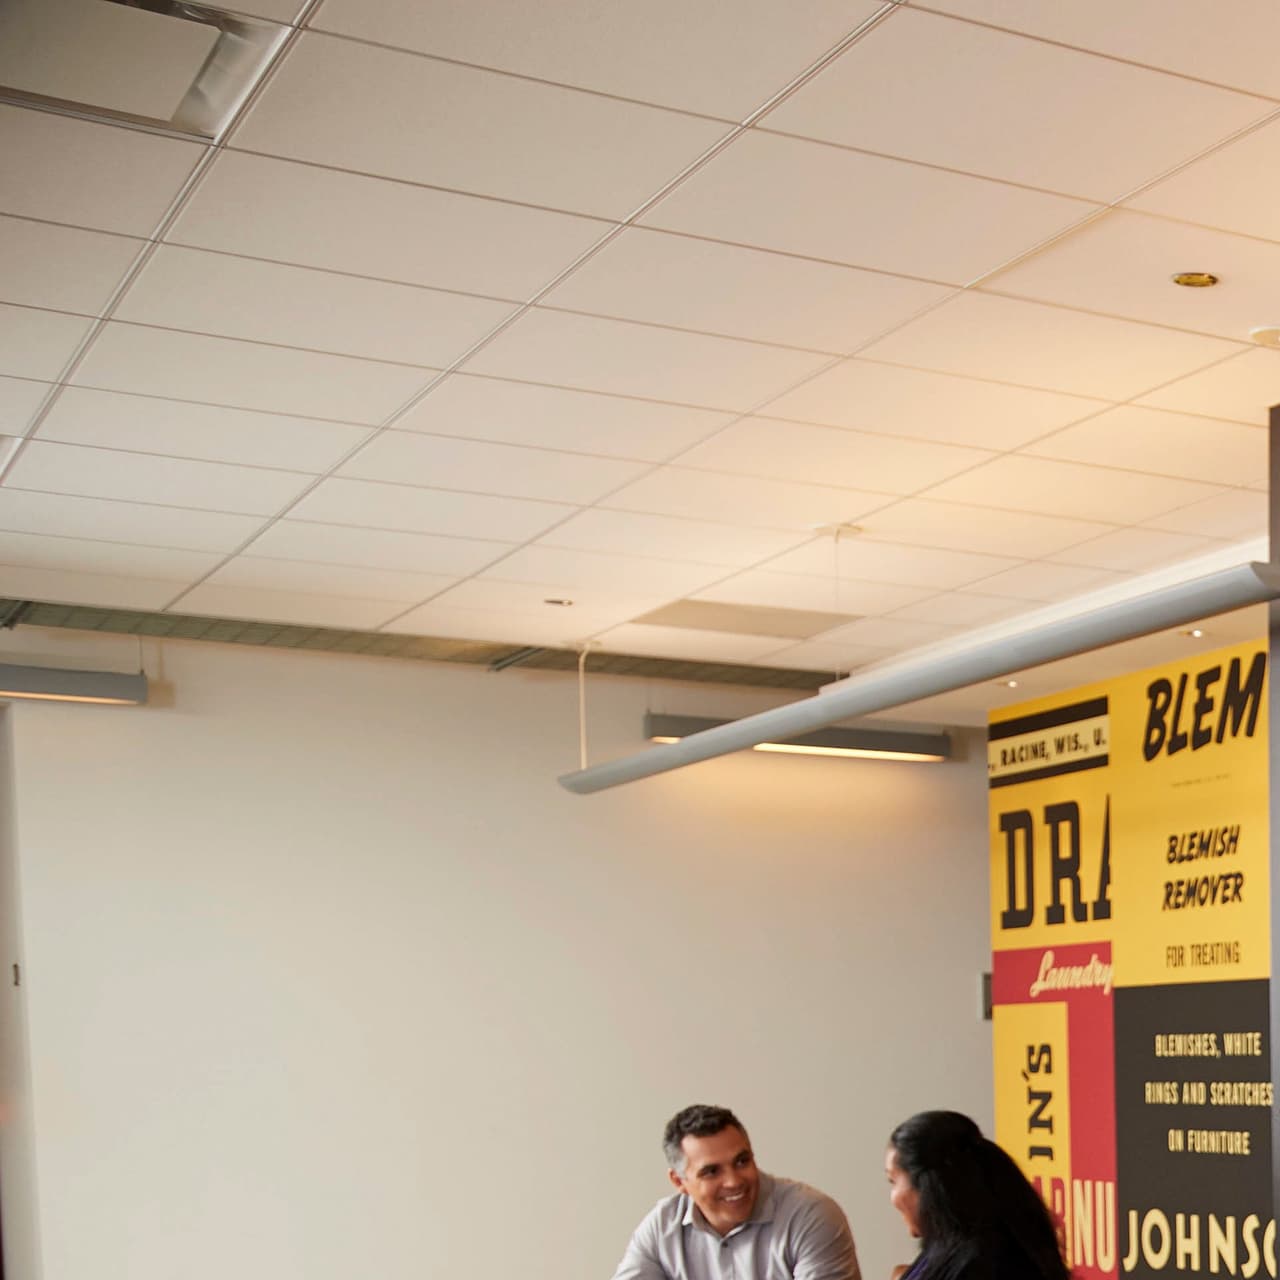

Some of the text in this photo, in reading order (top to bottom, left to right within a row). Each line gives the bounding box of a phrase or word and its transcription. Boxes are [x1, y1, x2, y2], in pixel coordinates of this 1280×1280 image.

[1142, 651, 1268, 762] BLEM
[1000, 739, 1050, 767] RACINE,
[1166, 825, 1241, 865] BLEMISH
[1161, 871, 1245, 912] REMOVER
[1165, 940, 1241, 969] FOR TREATING
[1155, 1031, 1262, 1059] BLEMISHES, WHITE
[1144, 1081, 1274, 1107] RINGS AND SCRATCHES
[1167, 1128, 1251, 1155] ON FURNITURE
